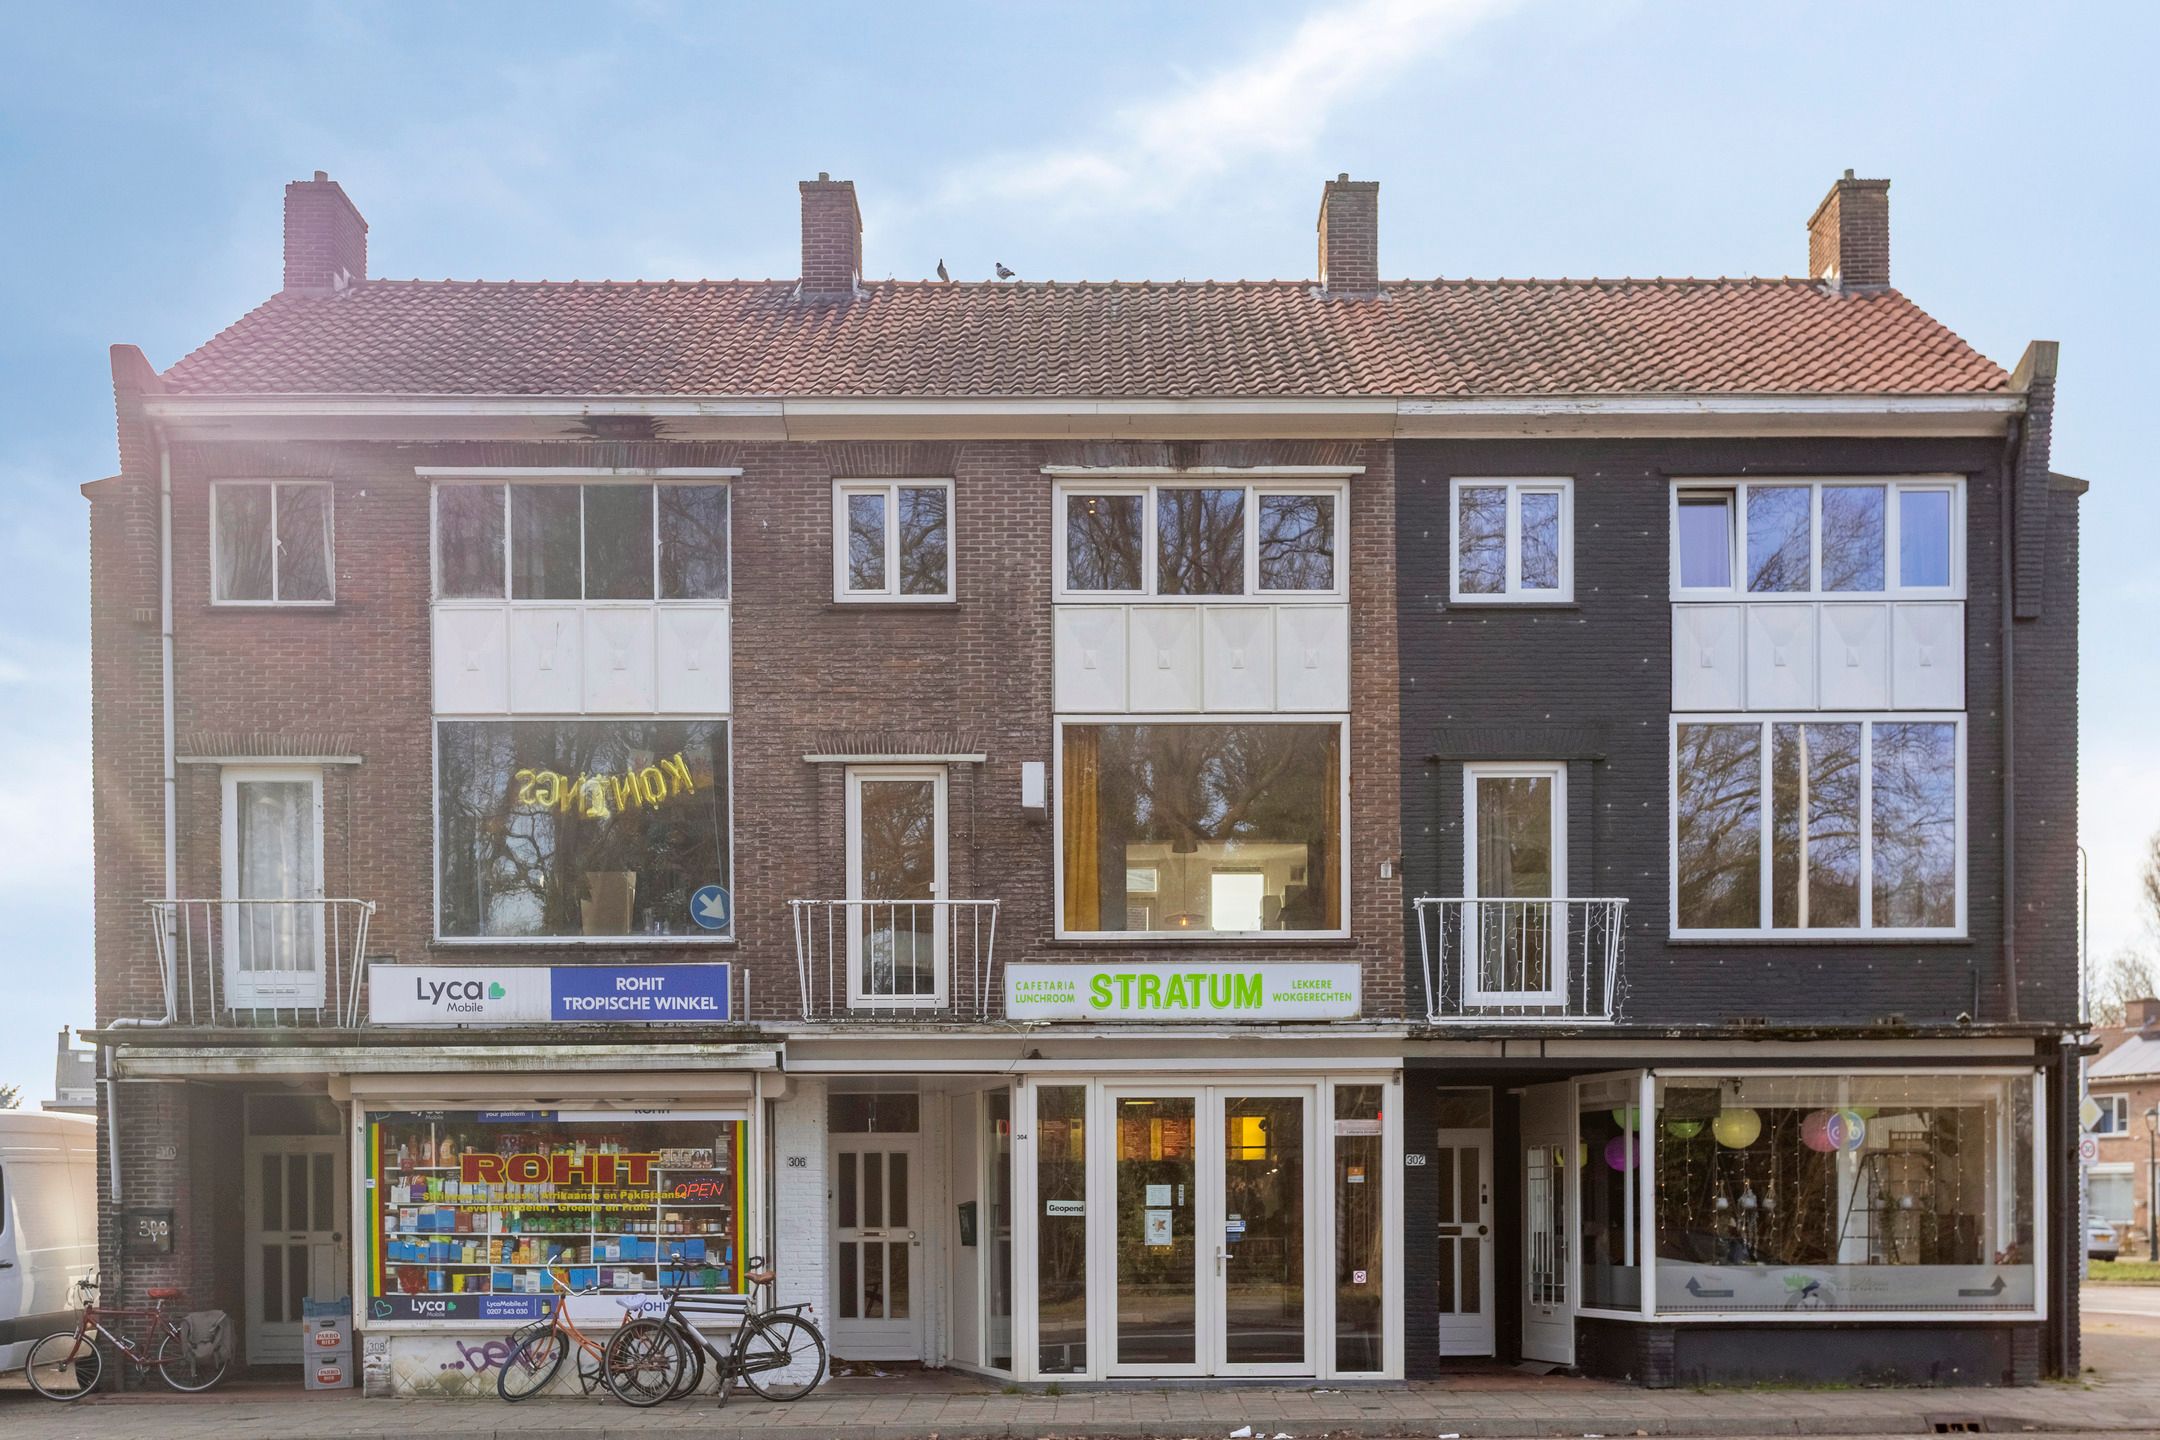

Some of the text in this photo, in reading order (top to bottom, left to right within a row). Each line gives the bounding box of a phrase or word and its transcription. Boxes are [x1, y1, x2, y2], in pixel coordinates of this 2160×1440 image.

[616, 977, 665, 990] ROHIT
[1015, 980, 1076, 991] CAFETARIA
[1292, 980, 1333, 989] LEKKERE
[416, 977, 483, 1005] Lyca
[1089, 973, 1263, 1010] STRATUM
[1015, 994, 1076, 1003] LUNCHROOM
[1272, 992, 1352, 1002] WOKGERECHTEN
[446, 1002, 483, 1012] Mobile
[563, 996, 718, 1010] TROPISCHE WINKEL
[788, 1157, 807, 1167] 306
[1406, 1155, 1425, 1165] 302
[460, 1153, 660, 1185] ROHIT
[674, 1183, 724, 1197] OPEN
[1049, 1204, 1084, 1213] Geopend
[411, 1299, 446, 1314] Lyca
[486, 1300, 529, 1308] LycaMobile.nl
[639, 1302, 672, 1312] OHI
[368, 1342, 386, 1352] 308
